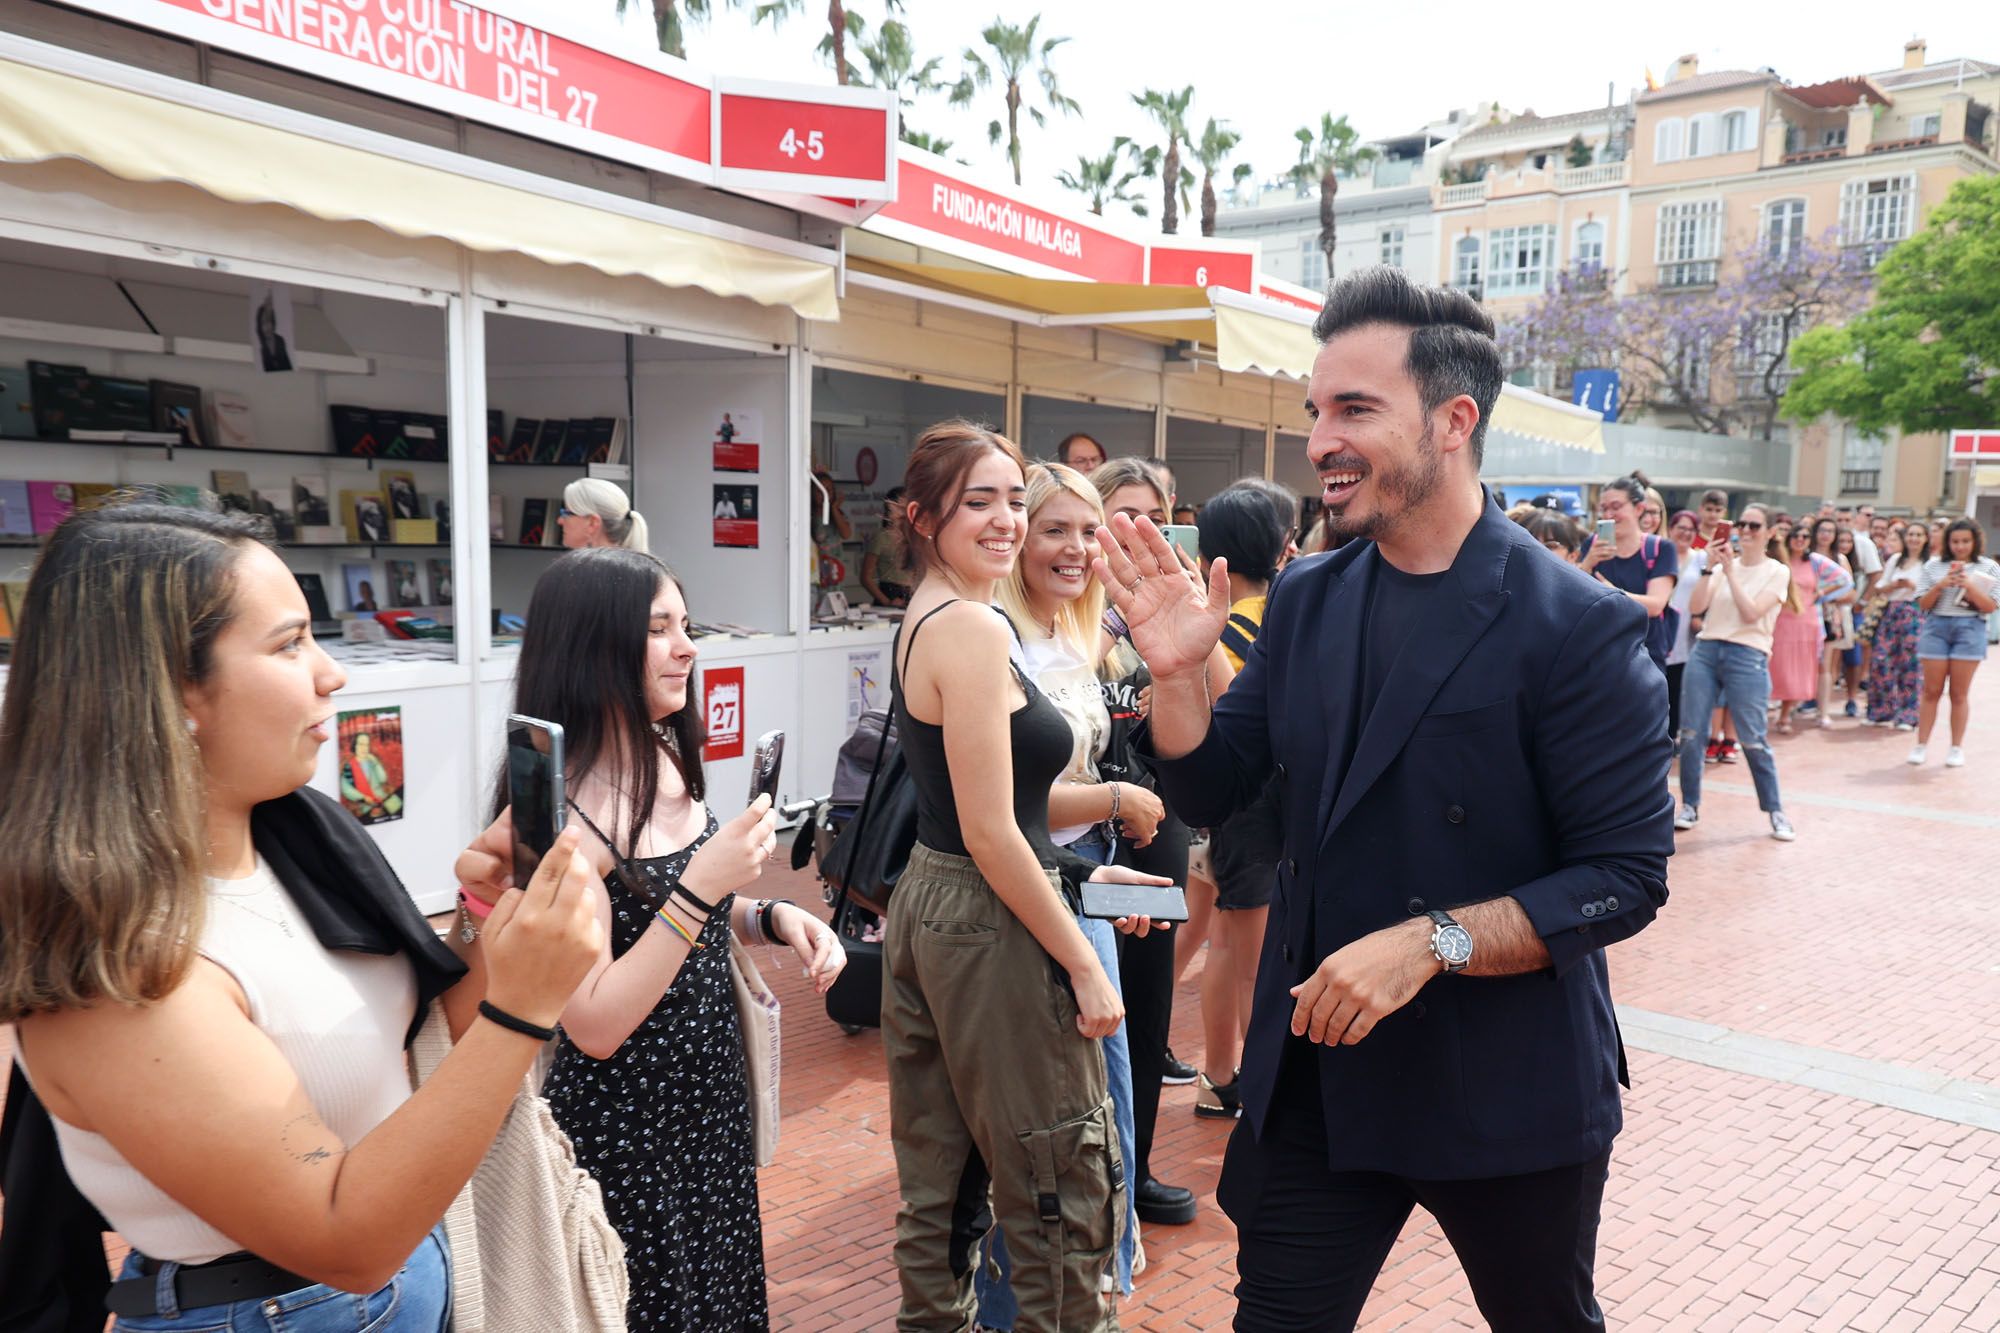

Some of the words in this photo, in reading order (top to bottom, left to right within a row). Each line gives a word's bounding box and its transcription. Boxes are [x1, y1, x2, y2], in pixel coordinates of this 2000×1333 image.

[379, 0, 559, 76] CULTURAL
[497, 62, 559, 120] DEL
[566, 86, 598, 130] 27
[779, 127, 825, 161] 4-5
[932, 183, 1022, 240] FUNDACIÓN
[1024, 213, 1082, 259] MALÁGA
[1195, 266, 1208, 288] 6
[712, 702, 736, 730] 27
